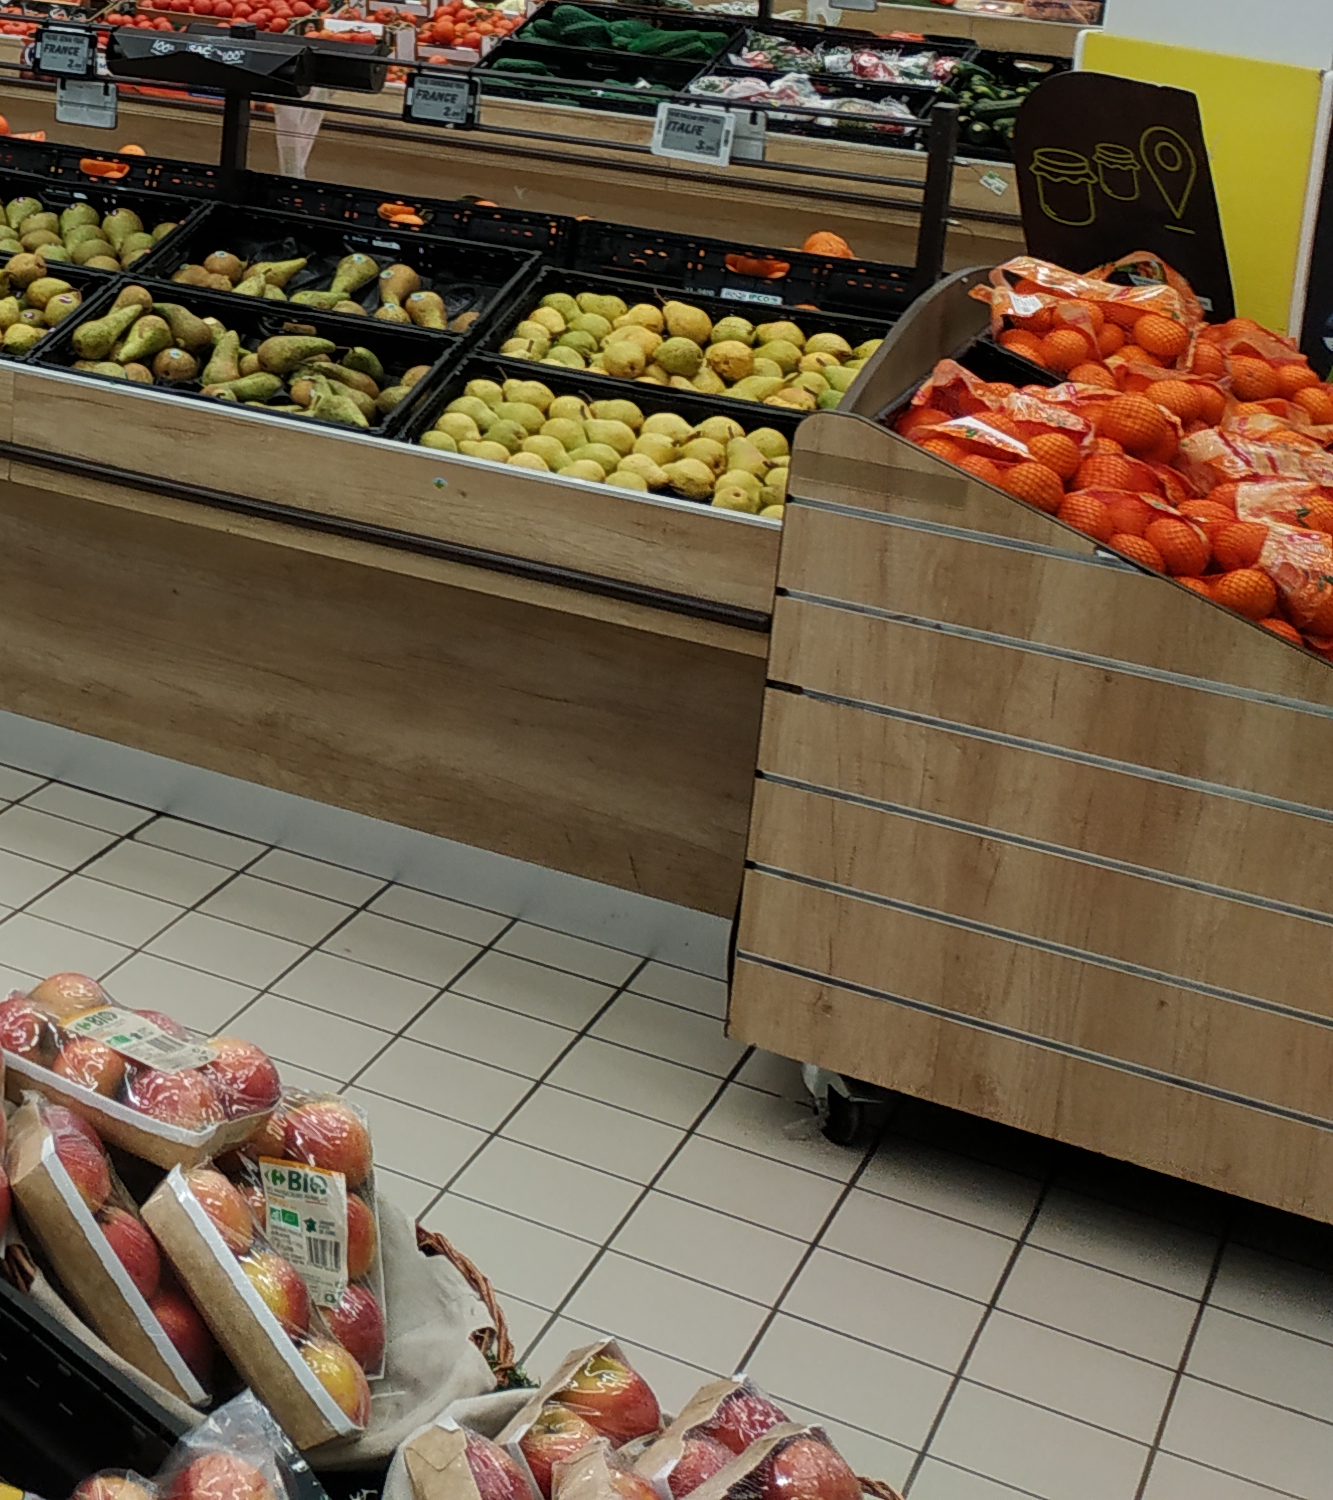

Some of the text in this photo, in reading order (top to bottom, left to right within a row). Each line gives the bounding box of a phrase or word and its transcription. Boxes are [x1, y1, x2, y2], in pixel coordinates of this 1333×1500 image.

[43, 43, 80, 56] FRANCE
[415, 90, 458, 104] FRANCE
[666, 120, 704, 135] ITALIE
[87, 1011, 118, 1026] BIO
